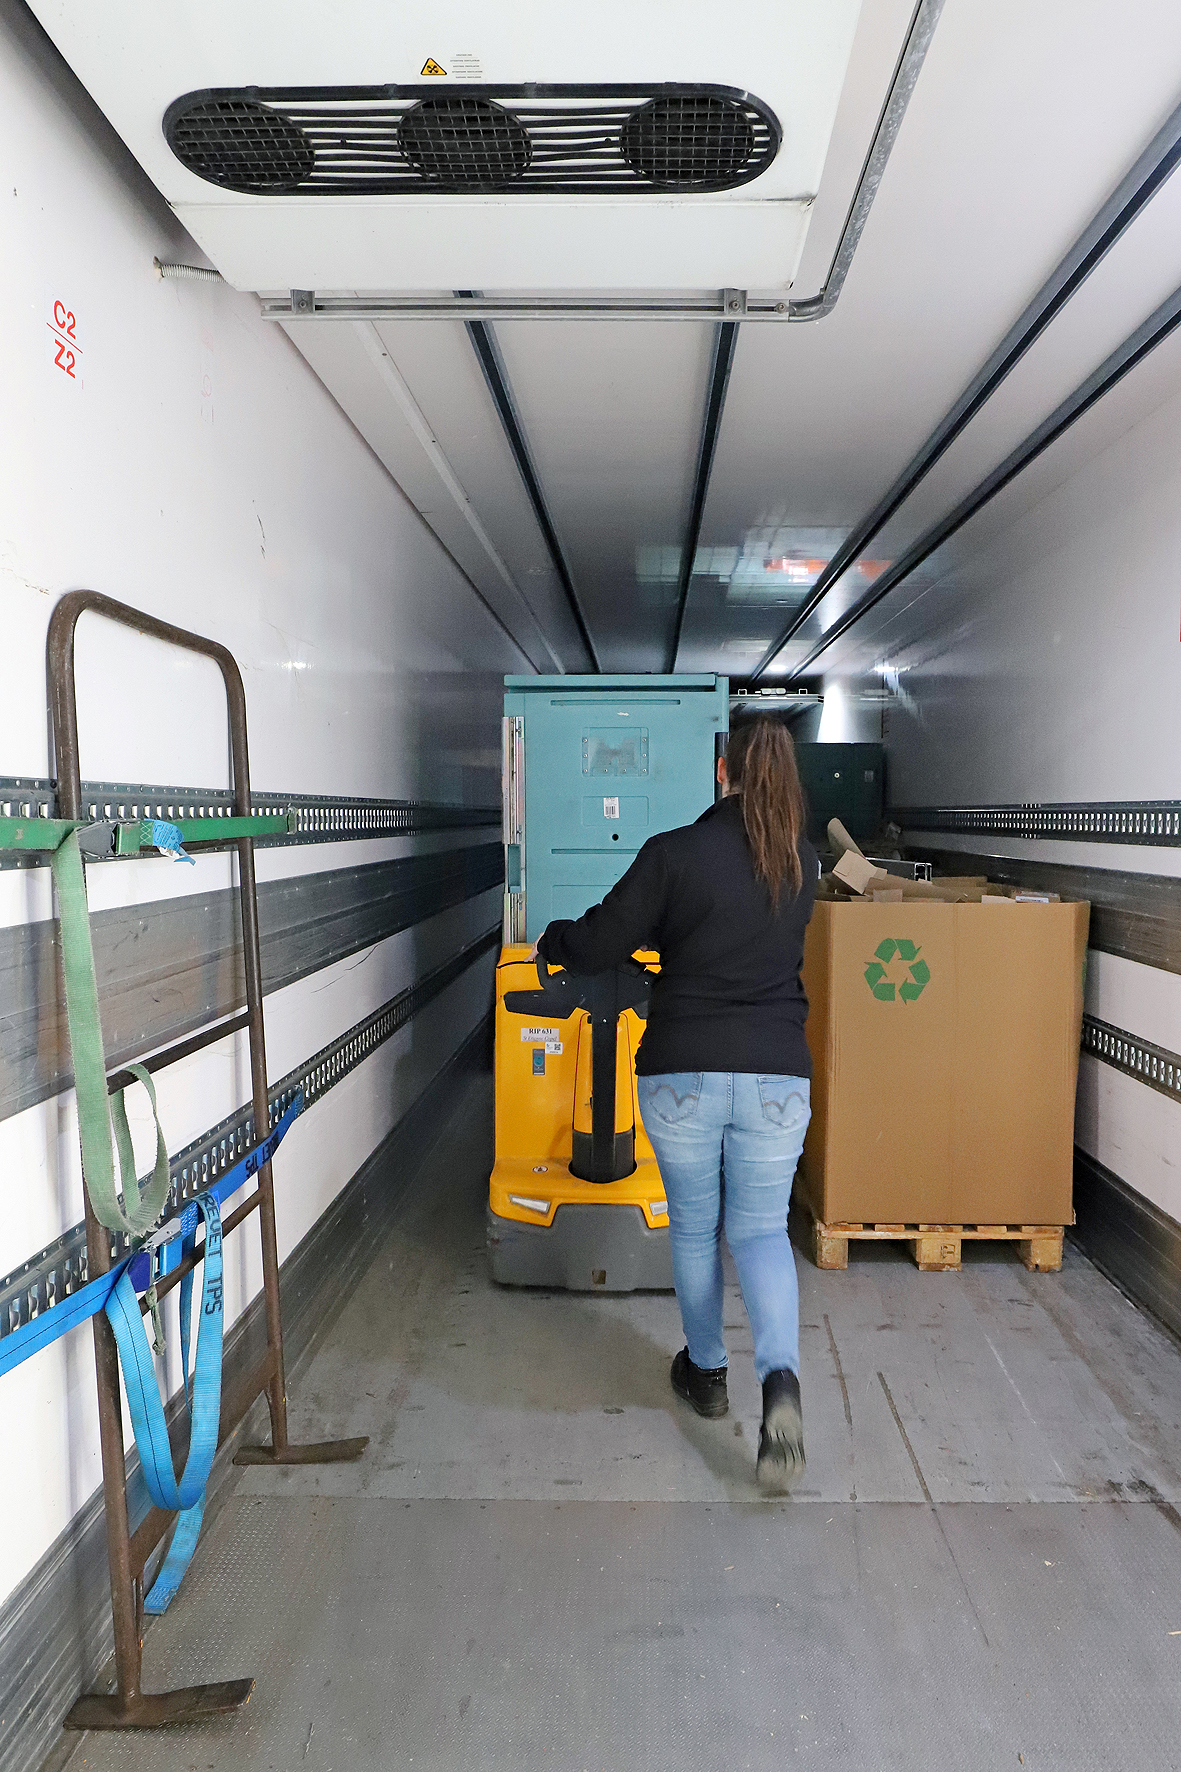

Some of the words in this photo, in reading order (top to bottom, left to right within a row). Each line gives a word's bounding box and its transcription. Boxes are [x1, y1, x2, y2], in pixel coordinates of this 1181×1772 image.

[53, 300, 76, 340] C2
[54, 338, 76, 379] Z2
[205, 1273, 222, 1315] TPS
